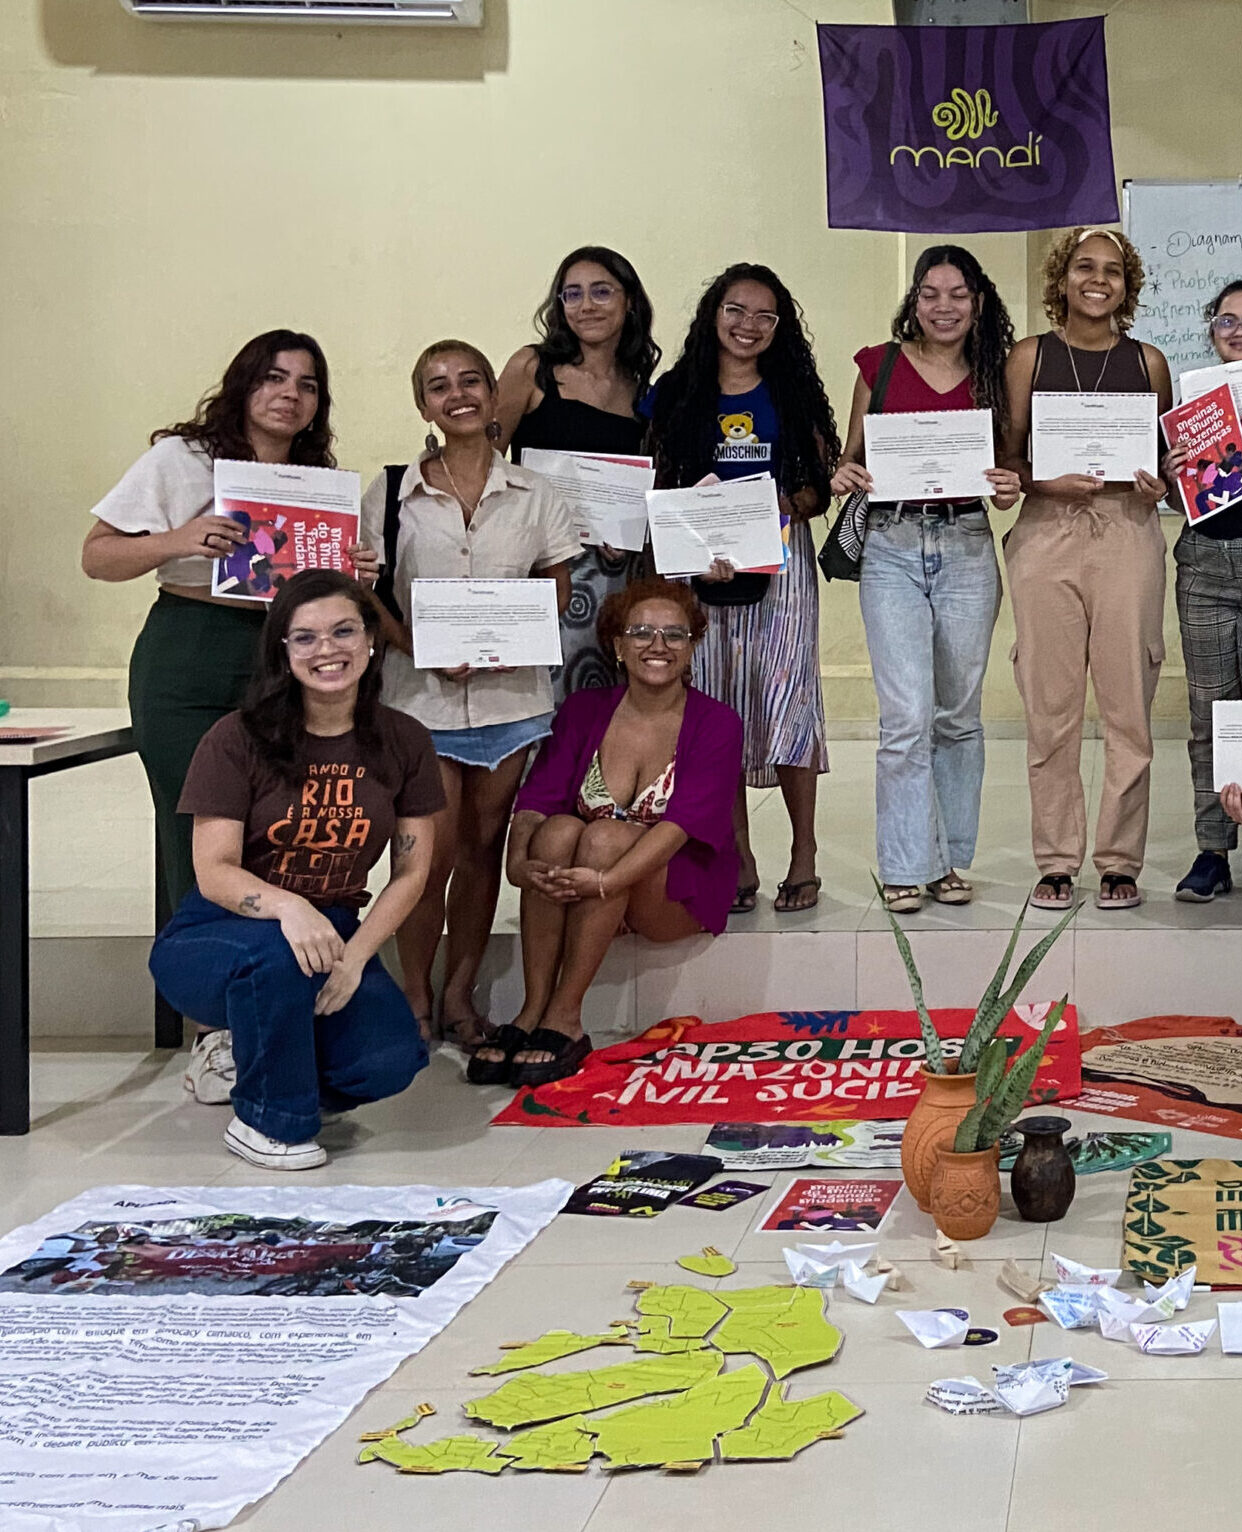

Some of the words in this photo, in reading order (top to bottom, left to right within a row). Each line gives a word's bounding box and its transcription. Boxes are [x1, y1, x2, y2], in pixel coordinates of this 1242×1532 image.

[890, 131, 1042, 168] mandí
[1176, 401, 1218, 432] Meninas
[1190, 408, 1224, 434] Mundo
[717, 445, 768, 459] MOSCHINO
[318, 522, 330, 538] do
[293, 521, 307, 569] Mudan
[306, 528, 318, 569] Fazen
[331, 527, 345, 569] Menin
[310, 763, 348, 776] ANDO
[356, 766, 366, 778] O
[302, 778, 353, 806] RIO
[302, 807, 310, 818] A
[317, 806, 363, 818] NOSSA
[267, 818, 371, 849] CASA
[631, 1041, 823, 1064] OP30
[838, 1038, 1013, 1060] HOS
[592, 1077, 729, 1105] IVIL
[756, 1079, 922, 1101] SOCIE
